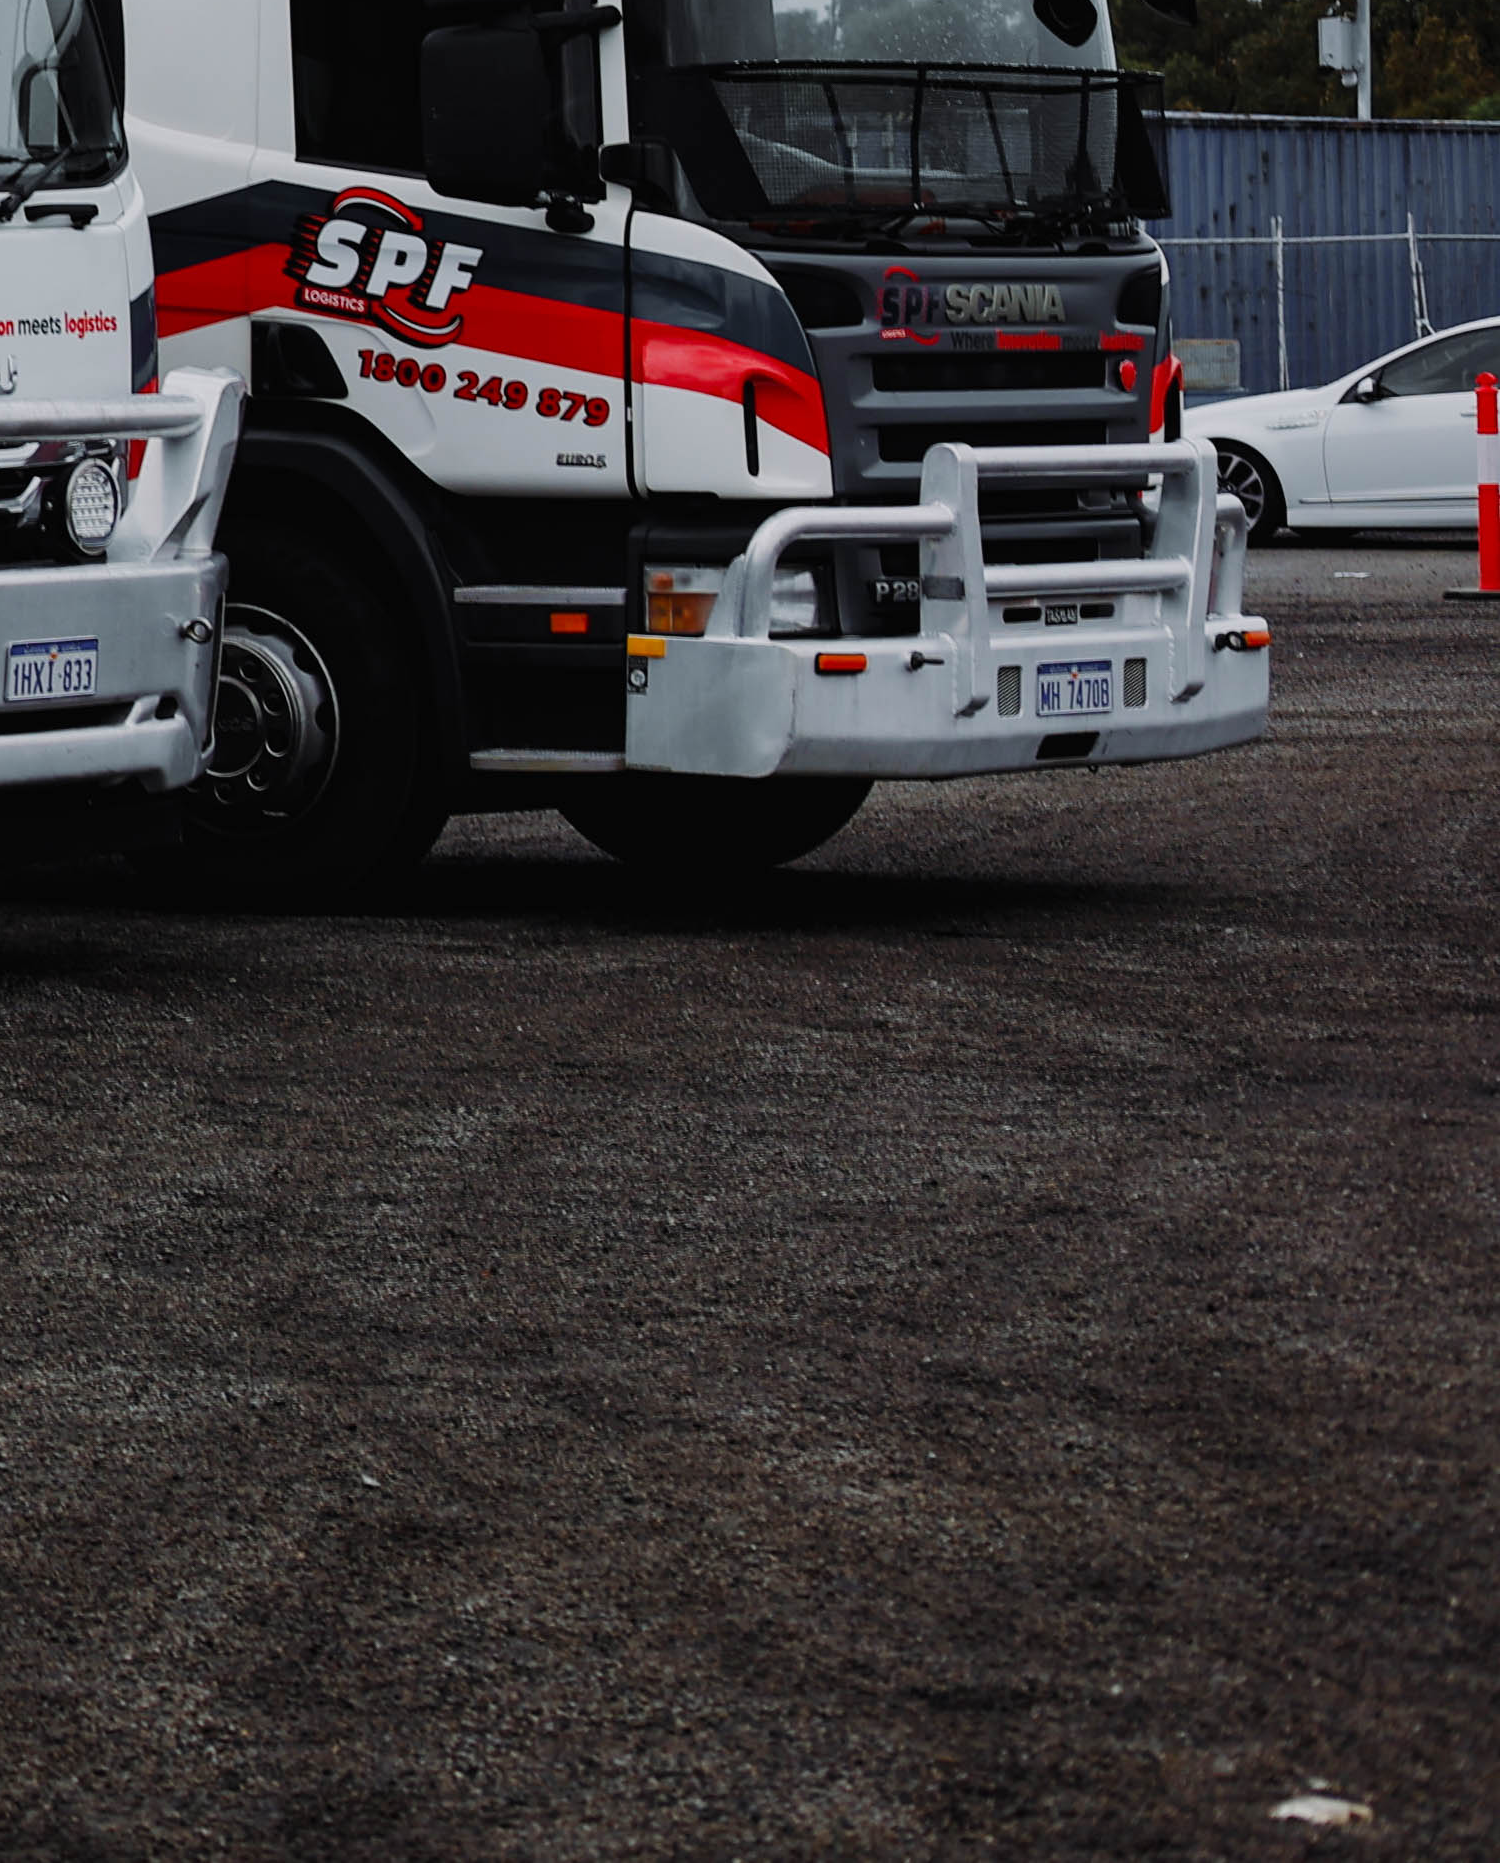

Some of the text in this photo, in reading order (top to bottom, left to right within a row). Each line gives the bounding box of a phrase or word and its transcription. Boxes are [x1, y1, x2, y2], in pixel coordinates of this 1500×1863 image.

[305, 219, 484, 310] SPF
[304, 287, 365, 313] LOGISTICS
[945, 283, 1066, 323] SCANIA
[18, 315, 62, 336] meets
[64, 310, 118, 340] logistics
[358, 349, 610, 427] 1800 249 879
[893, 581, 919, 602] 28
[1041, 681, 1060, 711] MH
